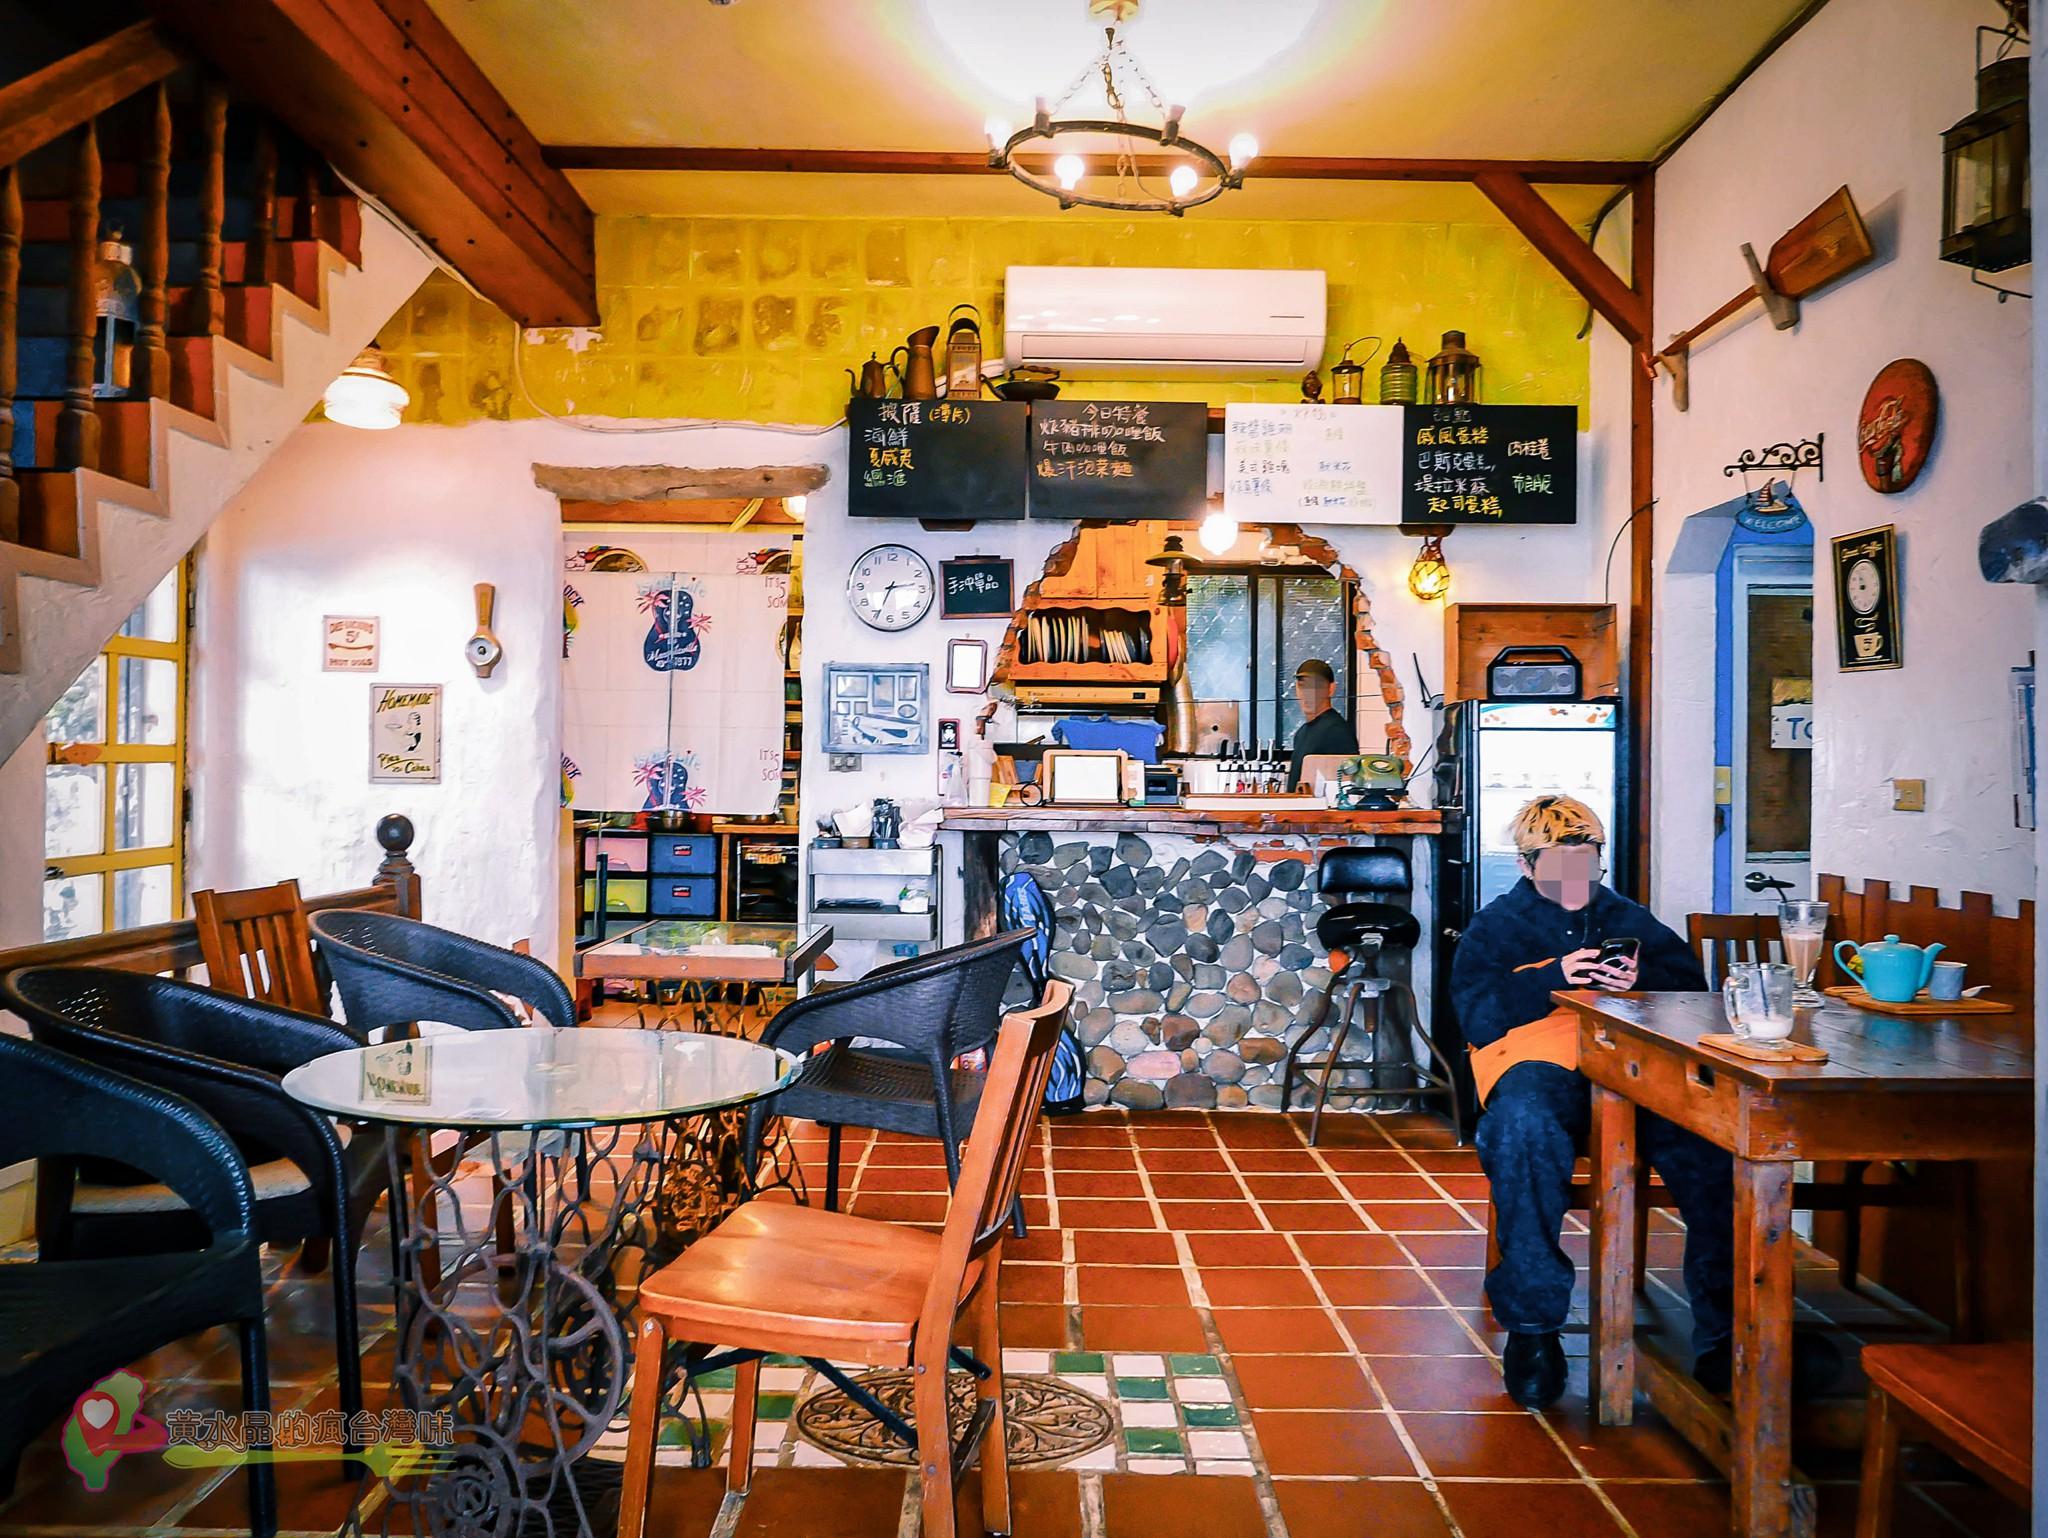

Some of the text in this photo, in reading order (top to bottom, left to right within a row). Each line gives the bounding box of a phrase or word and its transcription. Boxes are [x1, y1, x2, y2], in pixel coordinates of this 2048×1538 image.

[863, 426, 910, 448] 海鮮
[868, 447, 915, 470] 夏威夷
[947, 572, 1000, 595] 手沖單品
